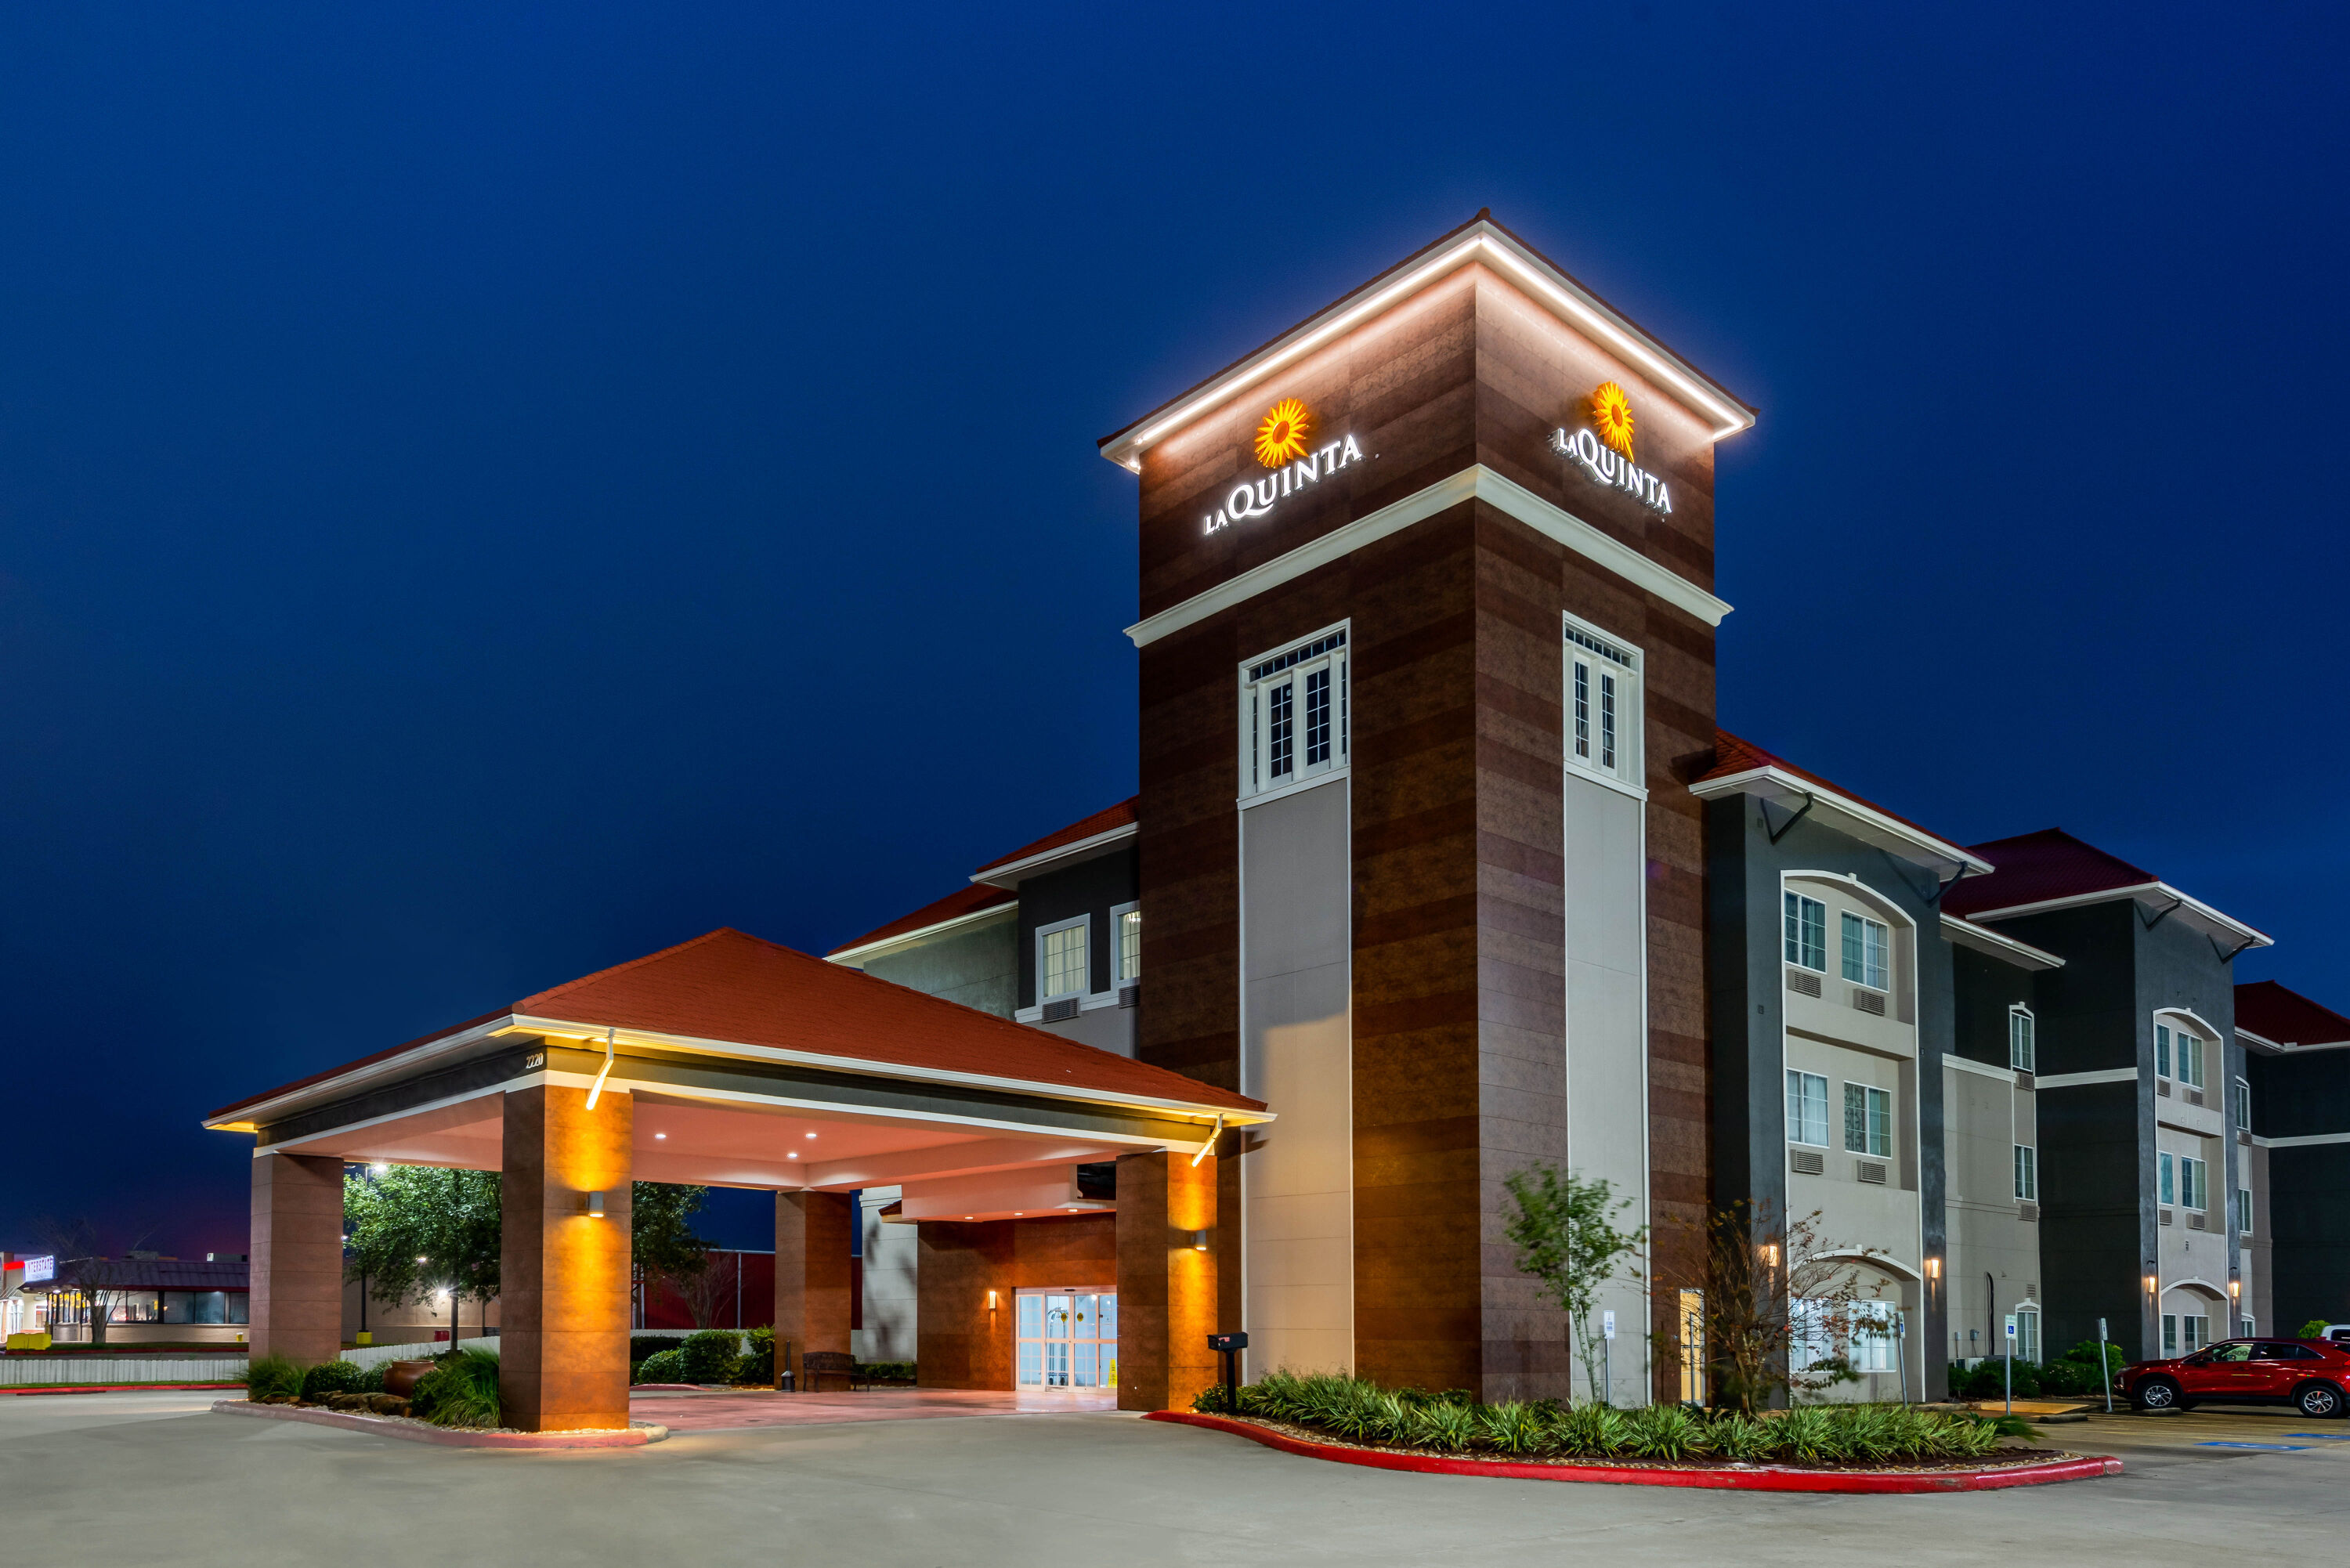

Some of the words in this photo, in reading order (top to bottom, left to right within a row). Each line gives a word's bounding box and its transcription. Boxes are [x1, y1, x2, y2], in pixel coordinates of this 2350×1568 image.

[1227, 433, 1362, 521] QUINTA
[1577, 428, 1672, 514] QUINTA
[526, 1053, 544, 1069] 2220
[27, 1258, 52, 1273] INTERSTATE
